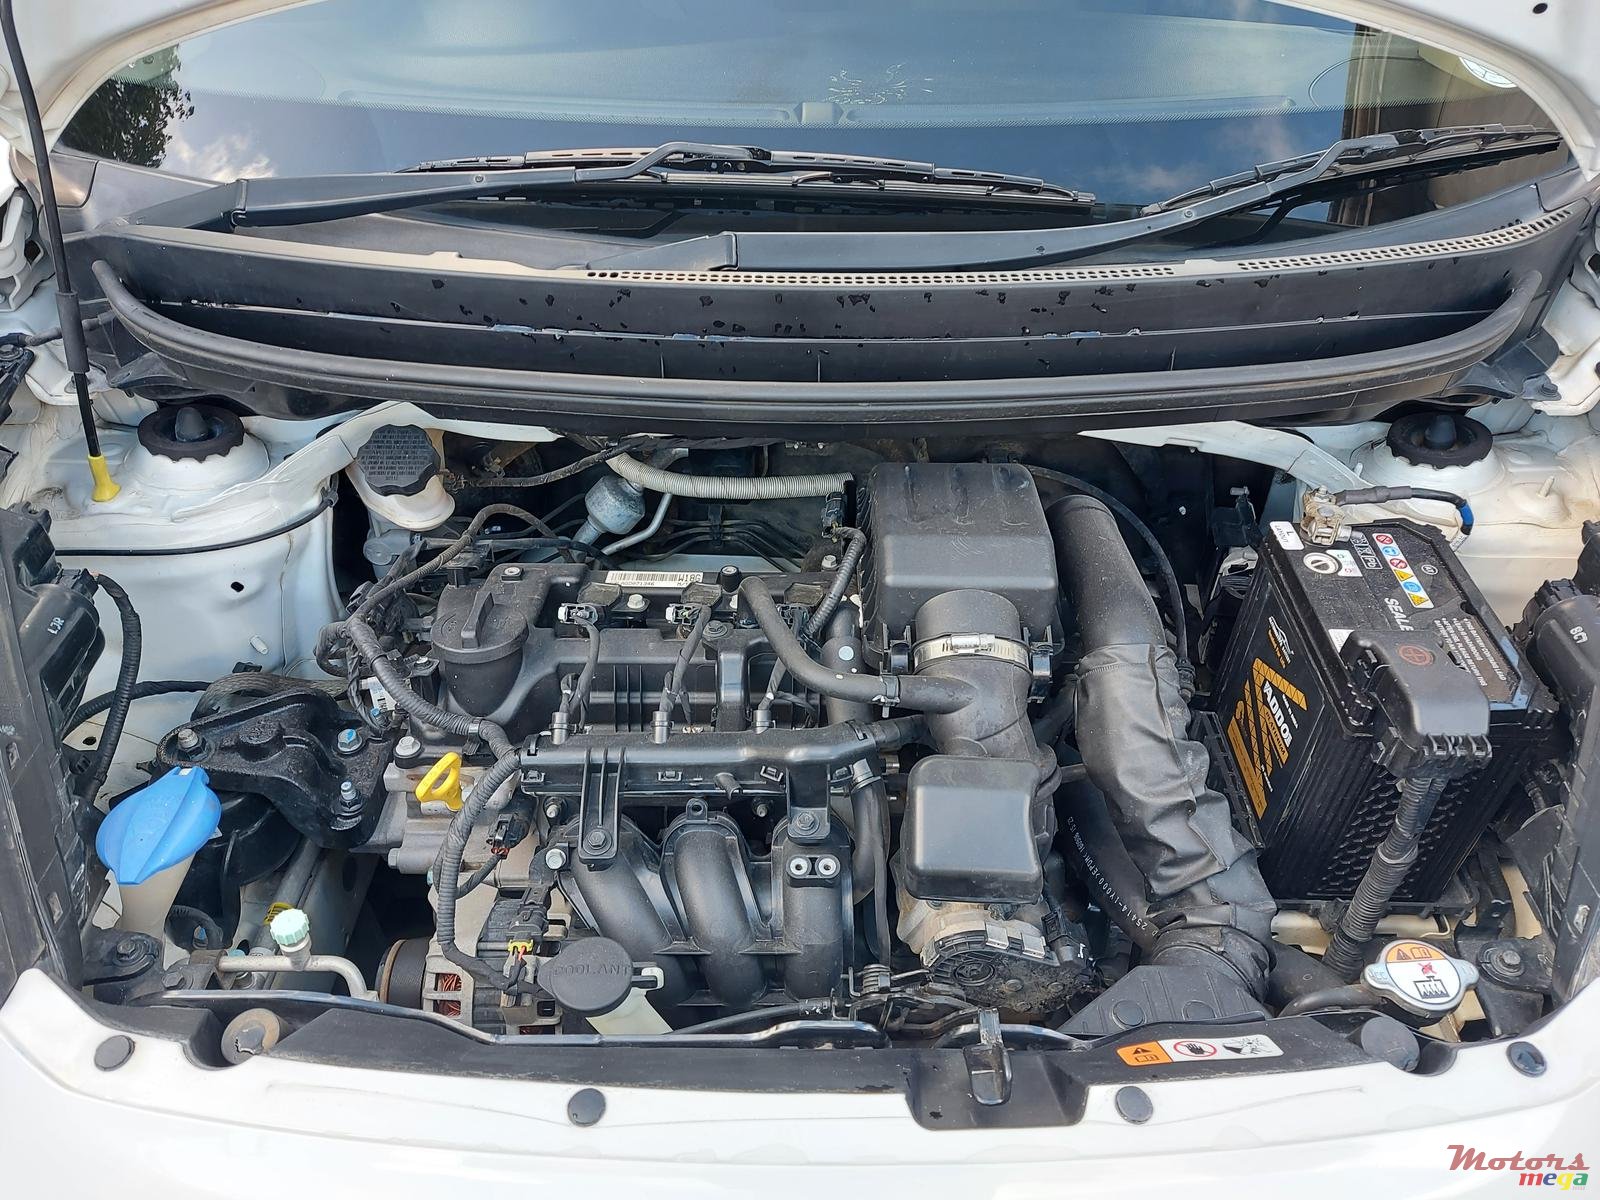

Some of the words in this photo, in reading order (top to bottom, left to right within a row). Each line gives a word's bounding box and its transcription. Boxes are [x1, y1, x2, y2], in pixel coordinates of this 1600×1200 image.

[1366, 557, 1379, 568] Pb
[1469, 628, 1485, 647] BATTERY
[1494, 667, 1506, 681] LEAD
[1098, 877, 1148, 931] 25414-1Y000
[553, 963, 631, 977] COOLANT
